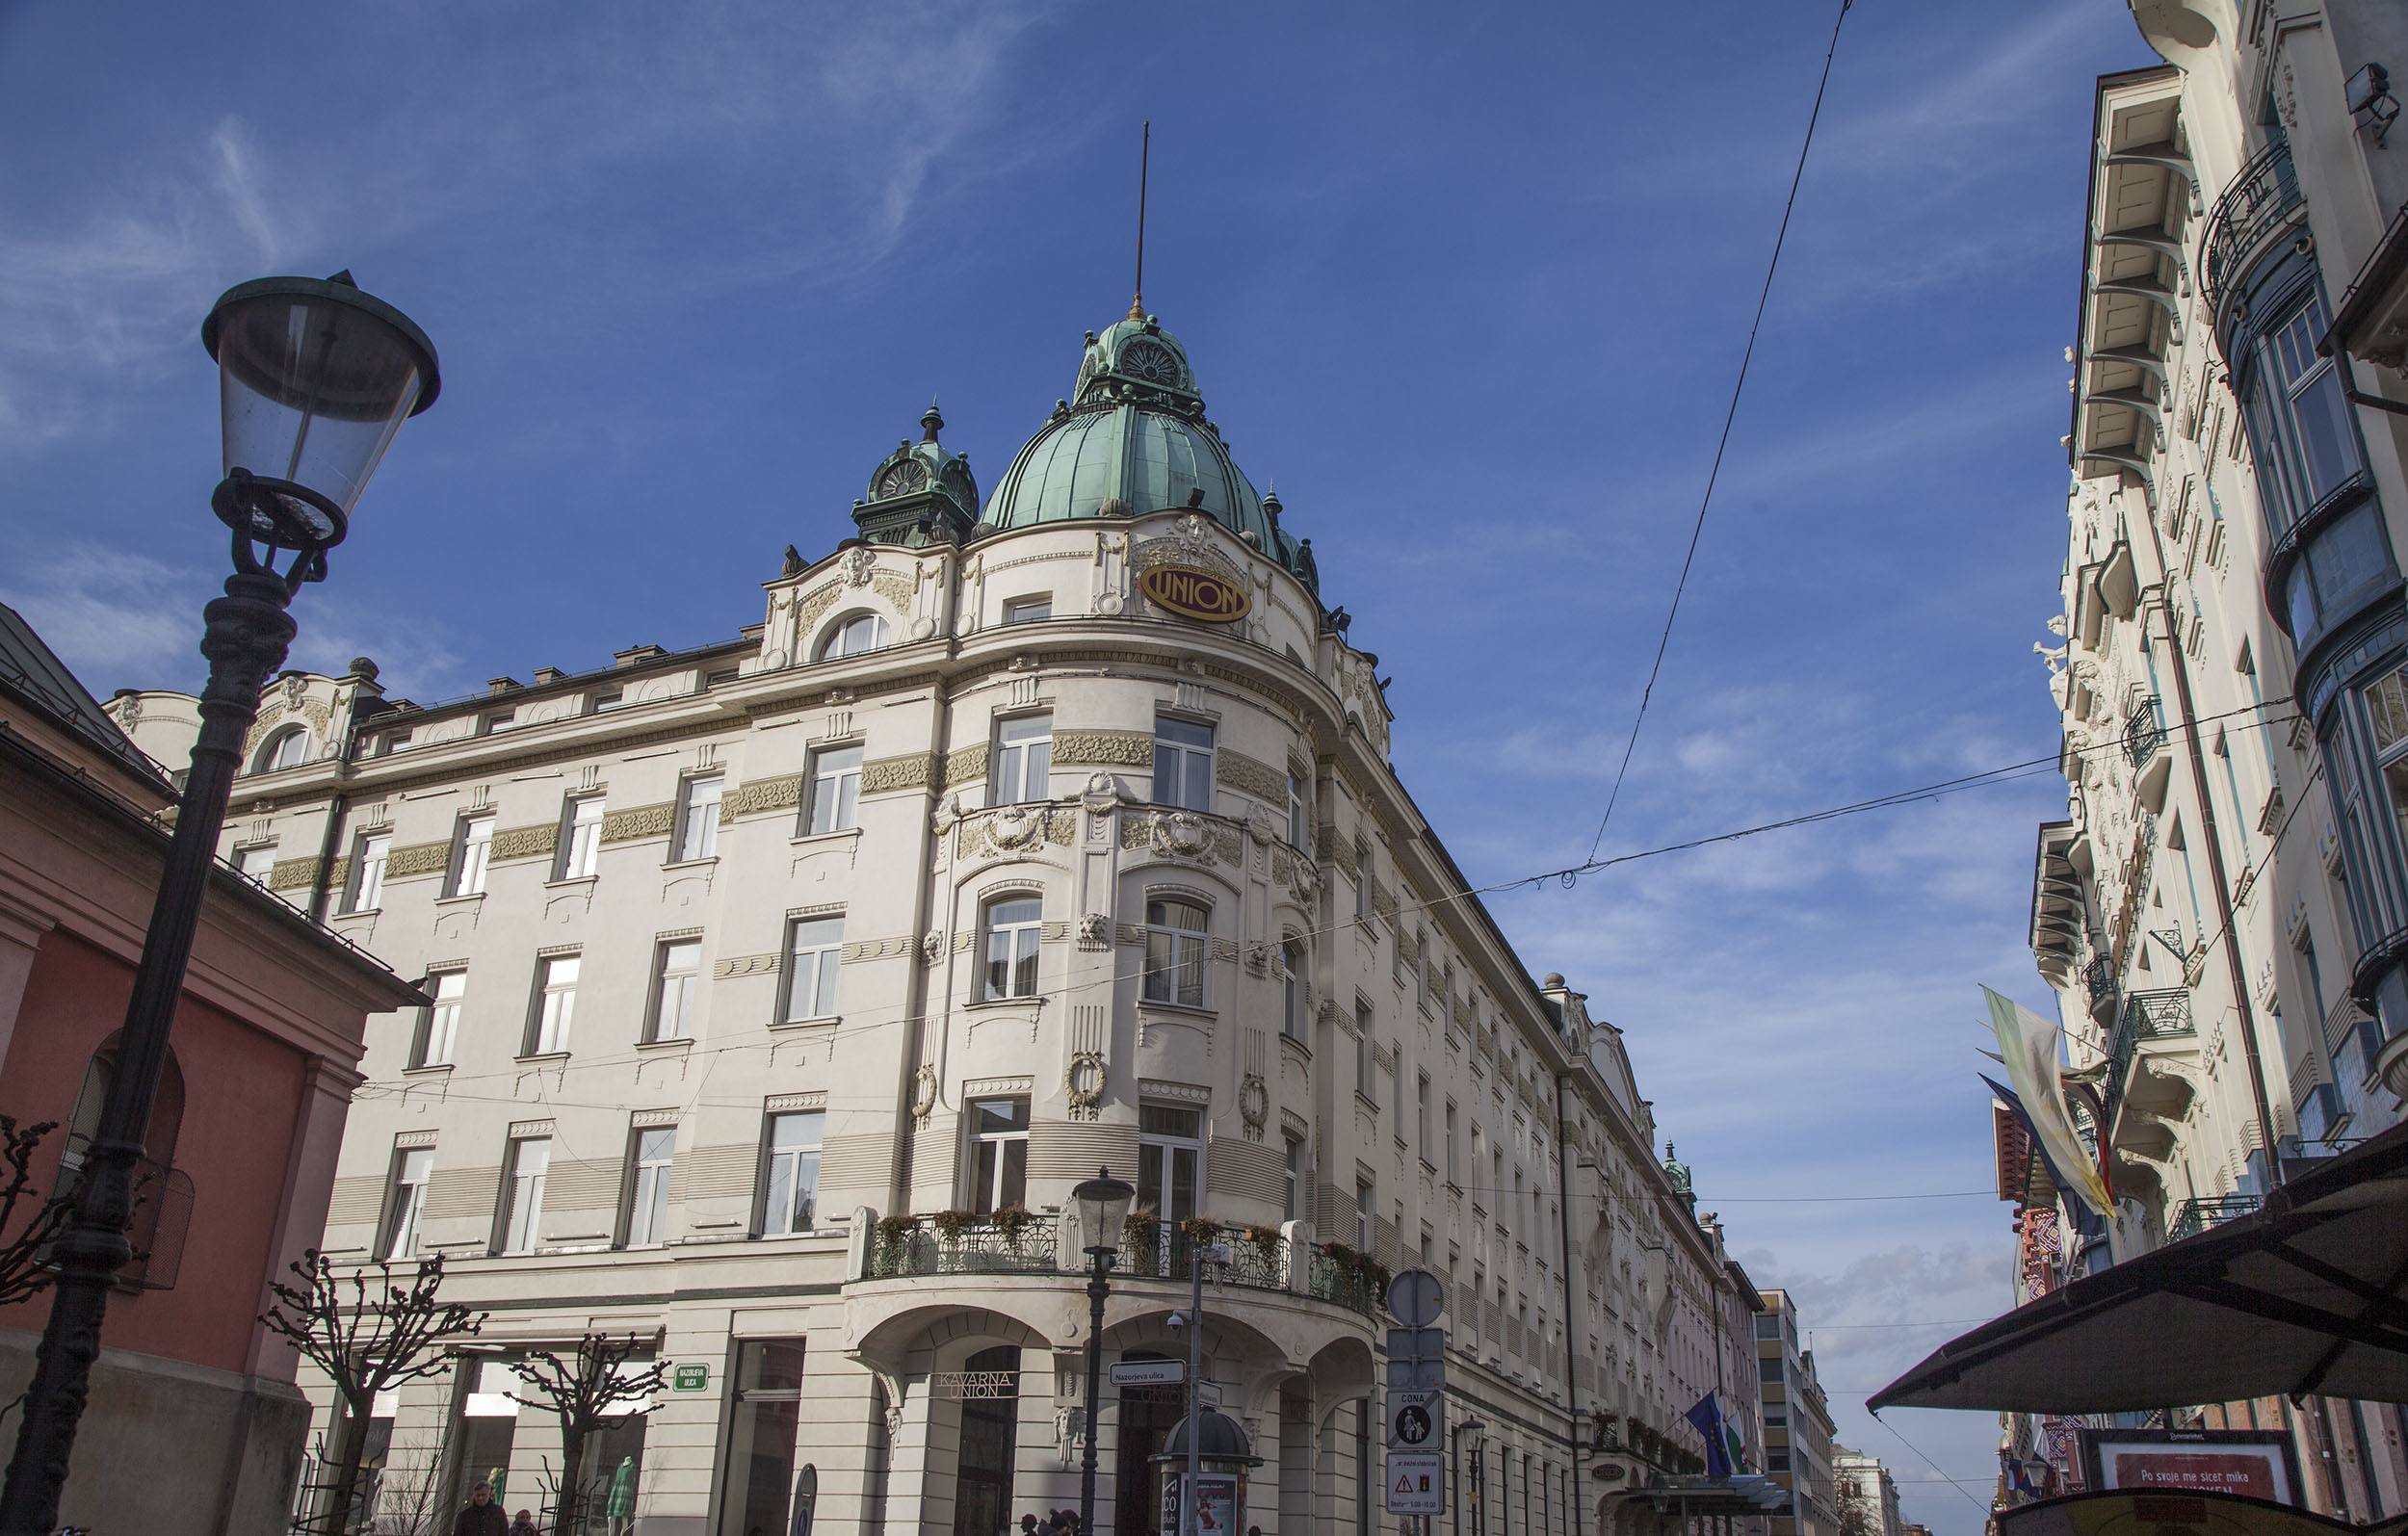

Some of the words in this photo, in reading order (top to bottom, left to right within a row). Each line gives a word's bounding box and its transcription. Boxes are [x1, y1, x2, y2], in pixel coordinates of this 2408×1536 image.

[1165, 564, 1198, 573] GRAND
[1200, 568, 1227, 583] HOTEL
[1156, 569, 1237, 615] UNION
[939, 1372, 1011, 1386] KAVARNA
[1115, 1373, 1148, 1382] Nazorjeva
[949, 1385, 999, 1398] UNION
[1401, 1393, 1425, 1403] CONA
[2141, 1470, 2153, 1481] Po
[2157, 1471, 2180, 1483] svoje
[2183, 1472, 2197, 1482] me
[2226, 1471, 2249, 1483] mika
